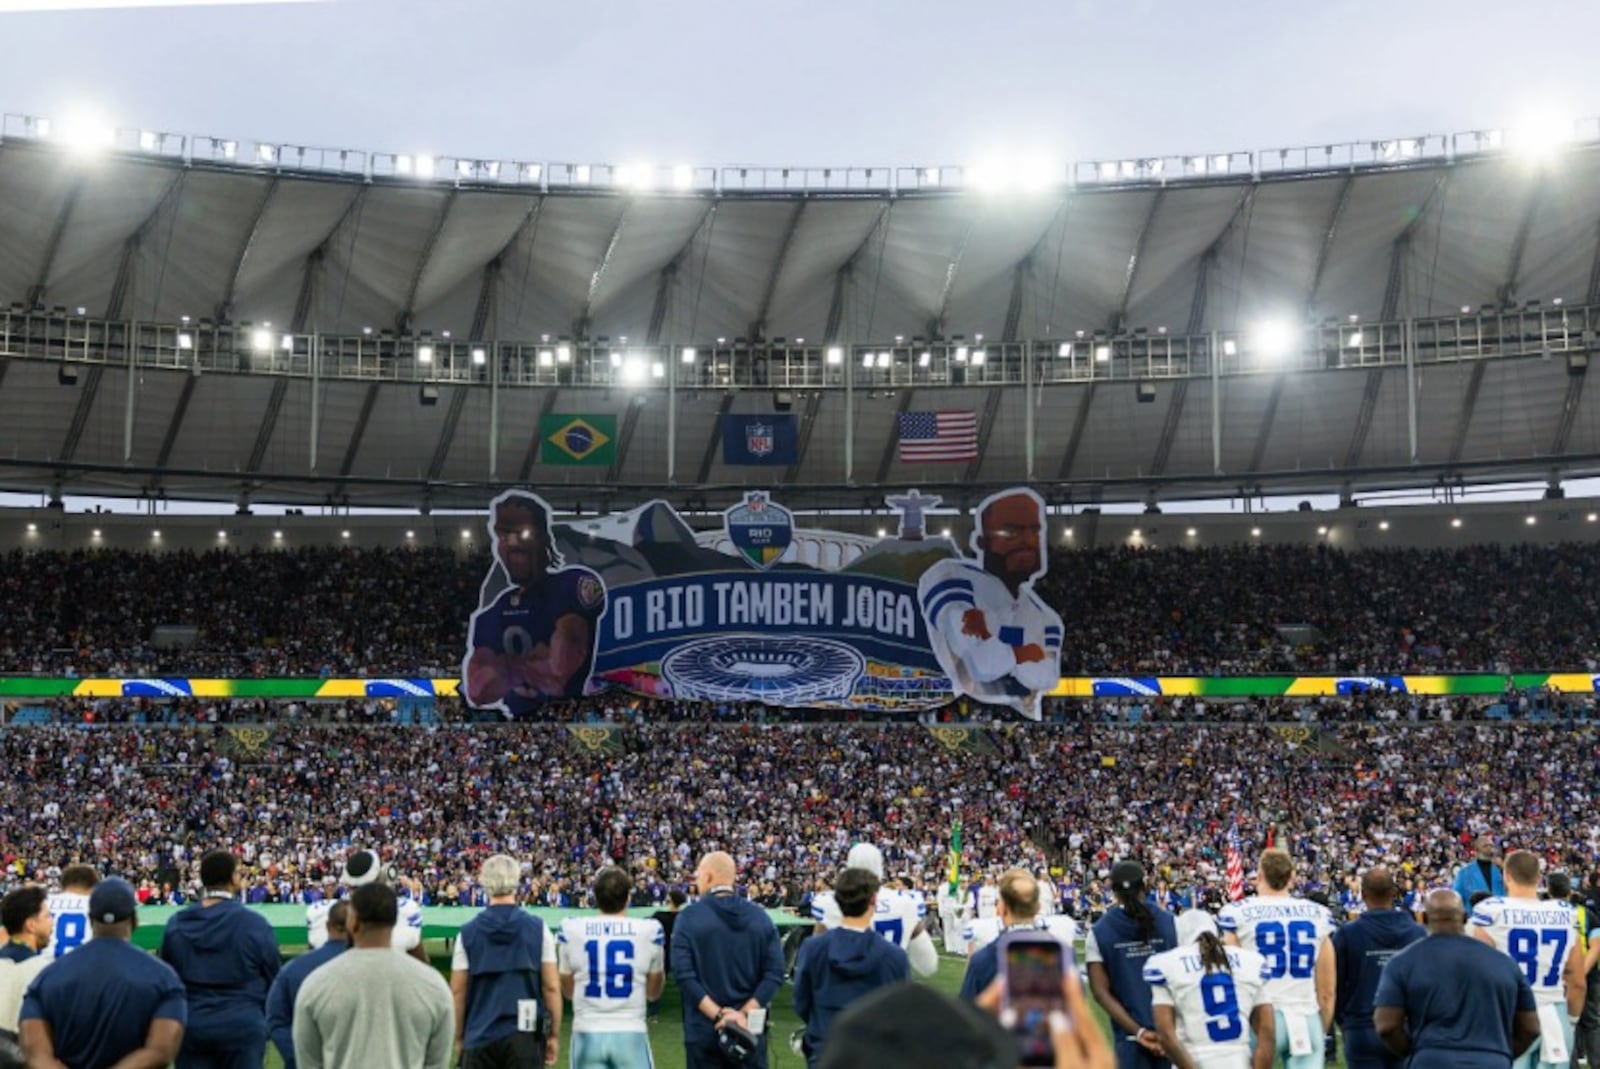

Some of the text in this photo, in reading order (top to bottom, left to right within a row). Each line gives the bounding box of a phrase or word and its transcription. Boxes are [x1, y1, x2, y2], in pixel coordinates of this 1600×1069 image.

[748, 528, 772, 538] RIO
[614, 595, 633, 640] O
[646, 584, 704, 633] RIO
[841, 584, 915, 638] JOGA
[585, 922, 637, 937] HOWELL
[1503, 908, 1570, 926] FERGUSON
[584, 939, 635, 998] 16
[1255, 920, 1316, 979] 86
[1508, 928, 1568, 988] 87
[1200, 971, 1242, 1042] 9
